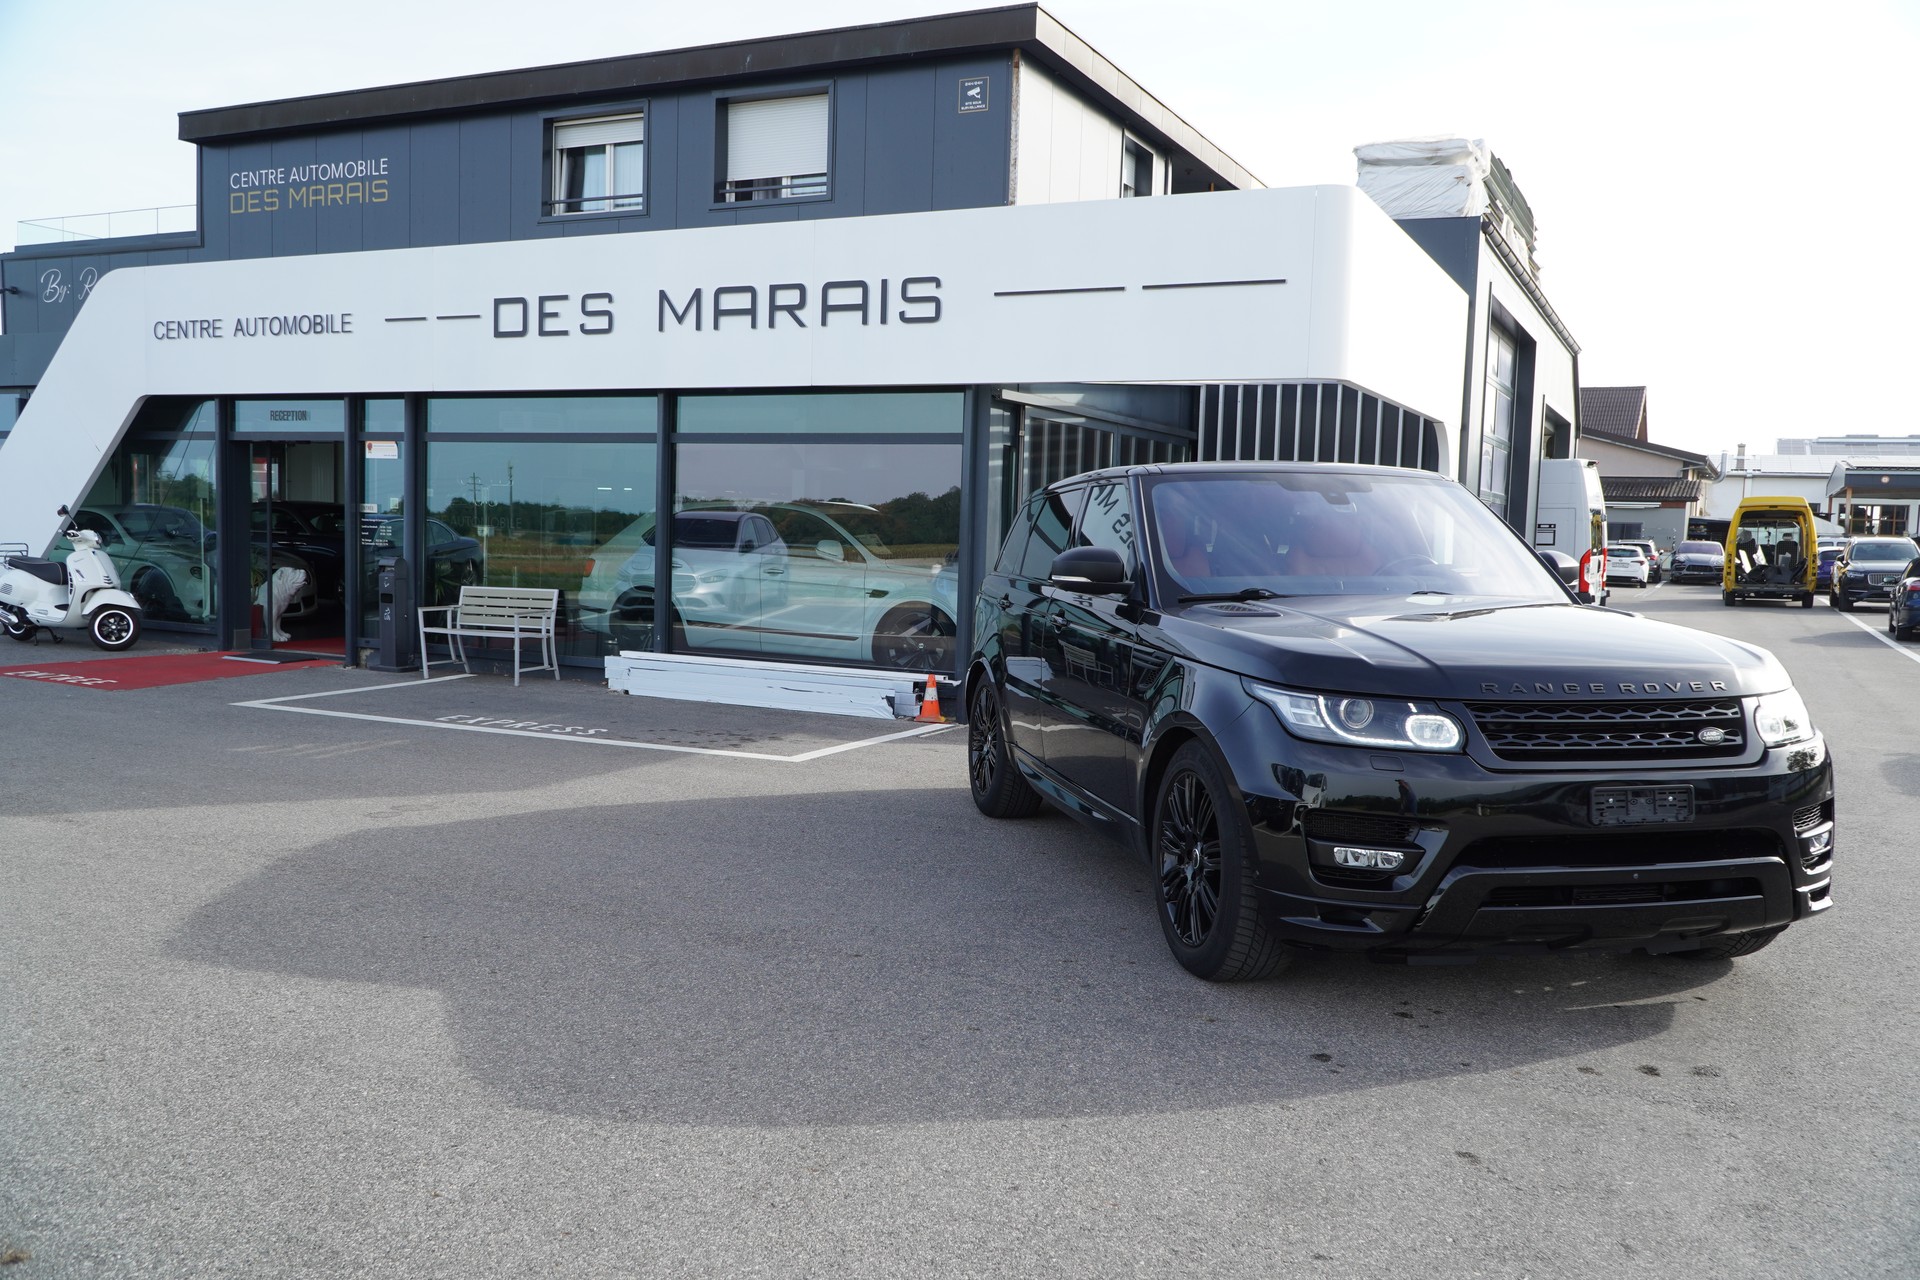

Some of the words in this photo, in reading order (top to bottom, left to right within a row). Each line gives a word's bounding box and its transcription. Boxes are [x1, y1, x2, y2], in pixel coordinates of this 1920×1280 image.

[230, 168, 285, 189] CENTRE
[289, 158, 388, 183] AUTOMOBILE
[230, 189, 279, 214] DES
[289, 179, 389, 209] MARAIS
[153, 319, 224, 340] CENTRE
[233, 313, 353, 338] AUTOMOBILE
[493, 292, 614, 338] DES
[658, 276, 942, 332] MARAIS
[270, 410, 307, 421] RECEPTION
[1480, 682, 1606, 695] RANGE
[1618, 680, 1729, 694] ROVER
[435, 714, 608, 735] EXPRESS
